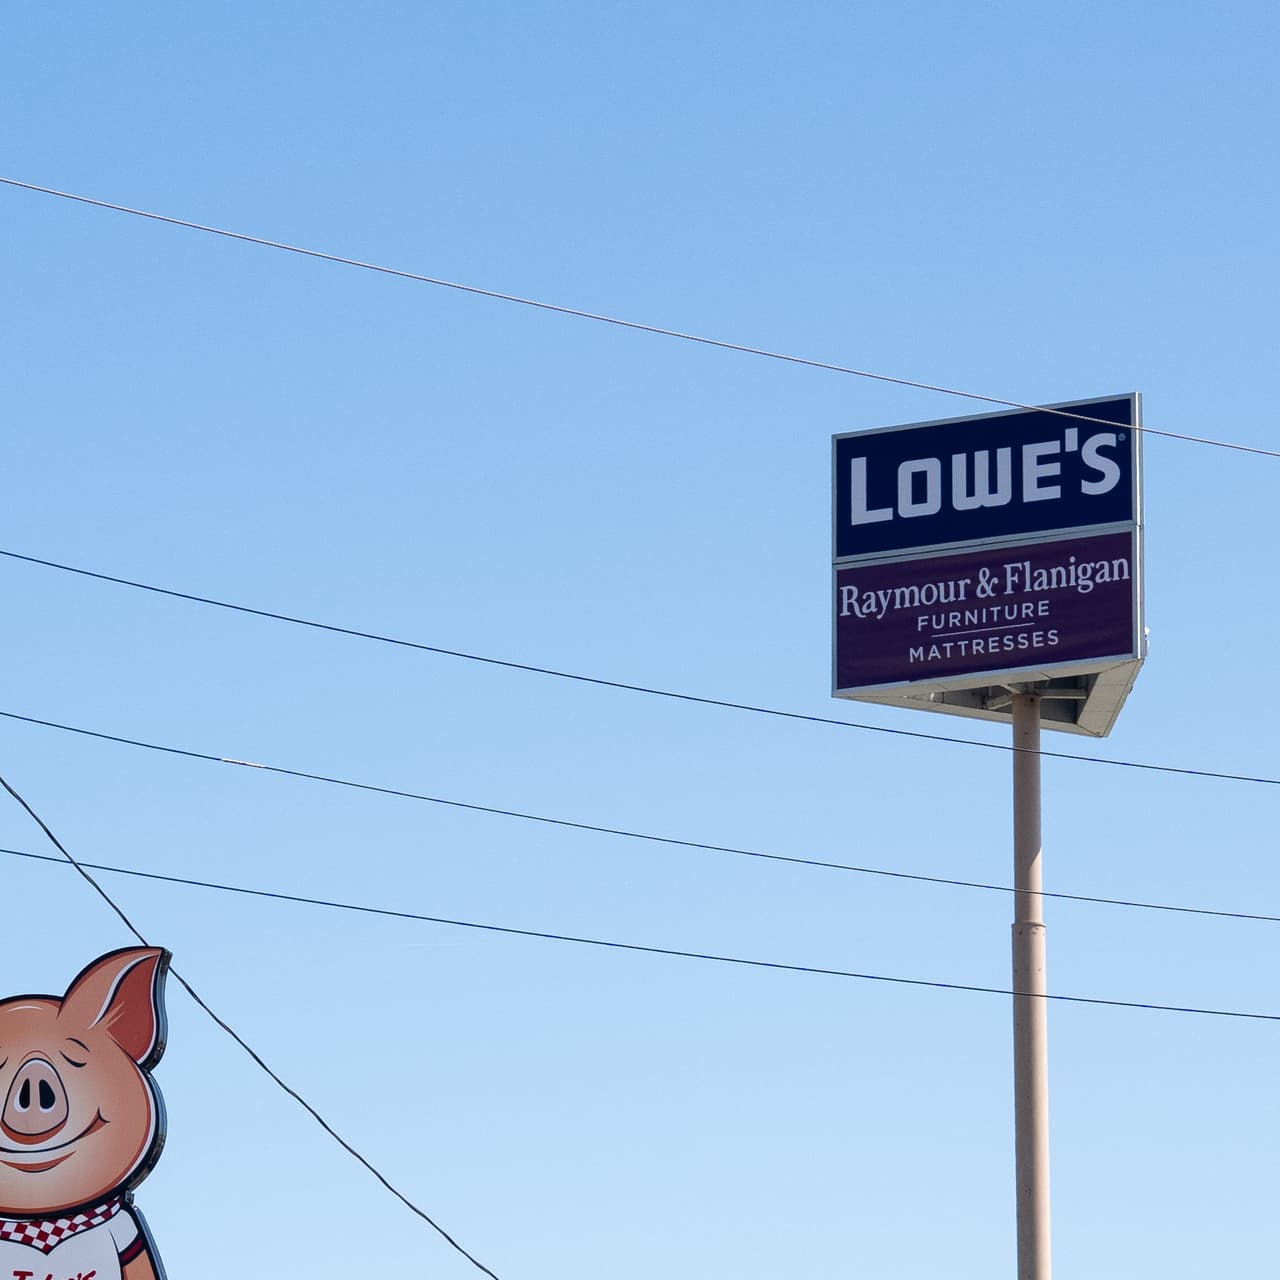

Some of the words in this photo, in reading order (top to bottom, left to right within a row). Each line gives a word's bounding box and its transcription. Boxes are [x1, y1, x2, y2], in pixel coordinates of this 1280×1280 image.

[850, 427, 1122, 526] LOWE'S
[839, 577, 972, 620] Raymour
[975, 567, 999, 599] &
[1003, 556, 1131, 594] Flanigan
[917, 600, 1050, 632] FURNITURE
[909, 630, 1060, 663] MATTRESSES
